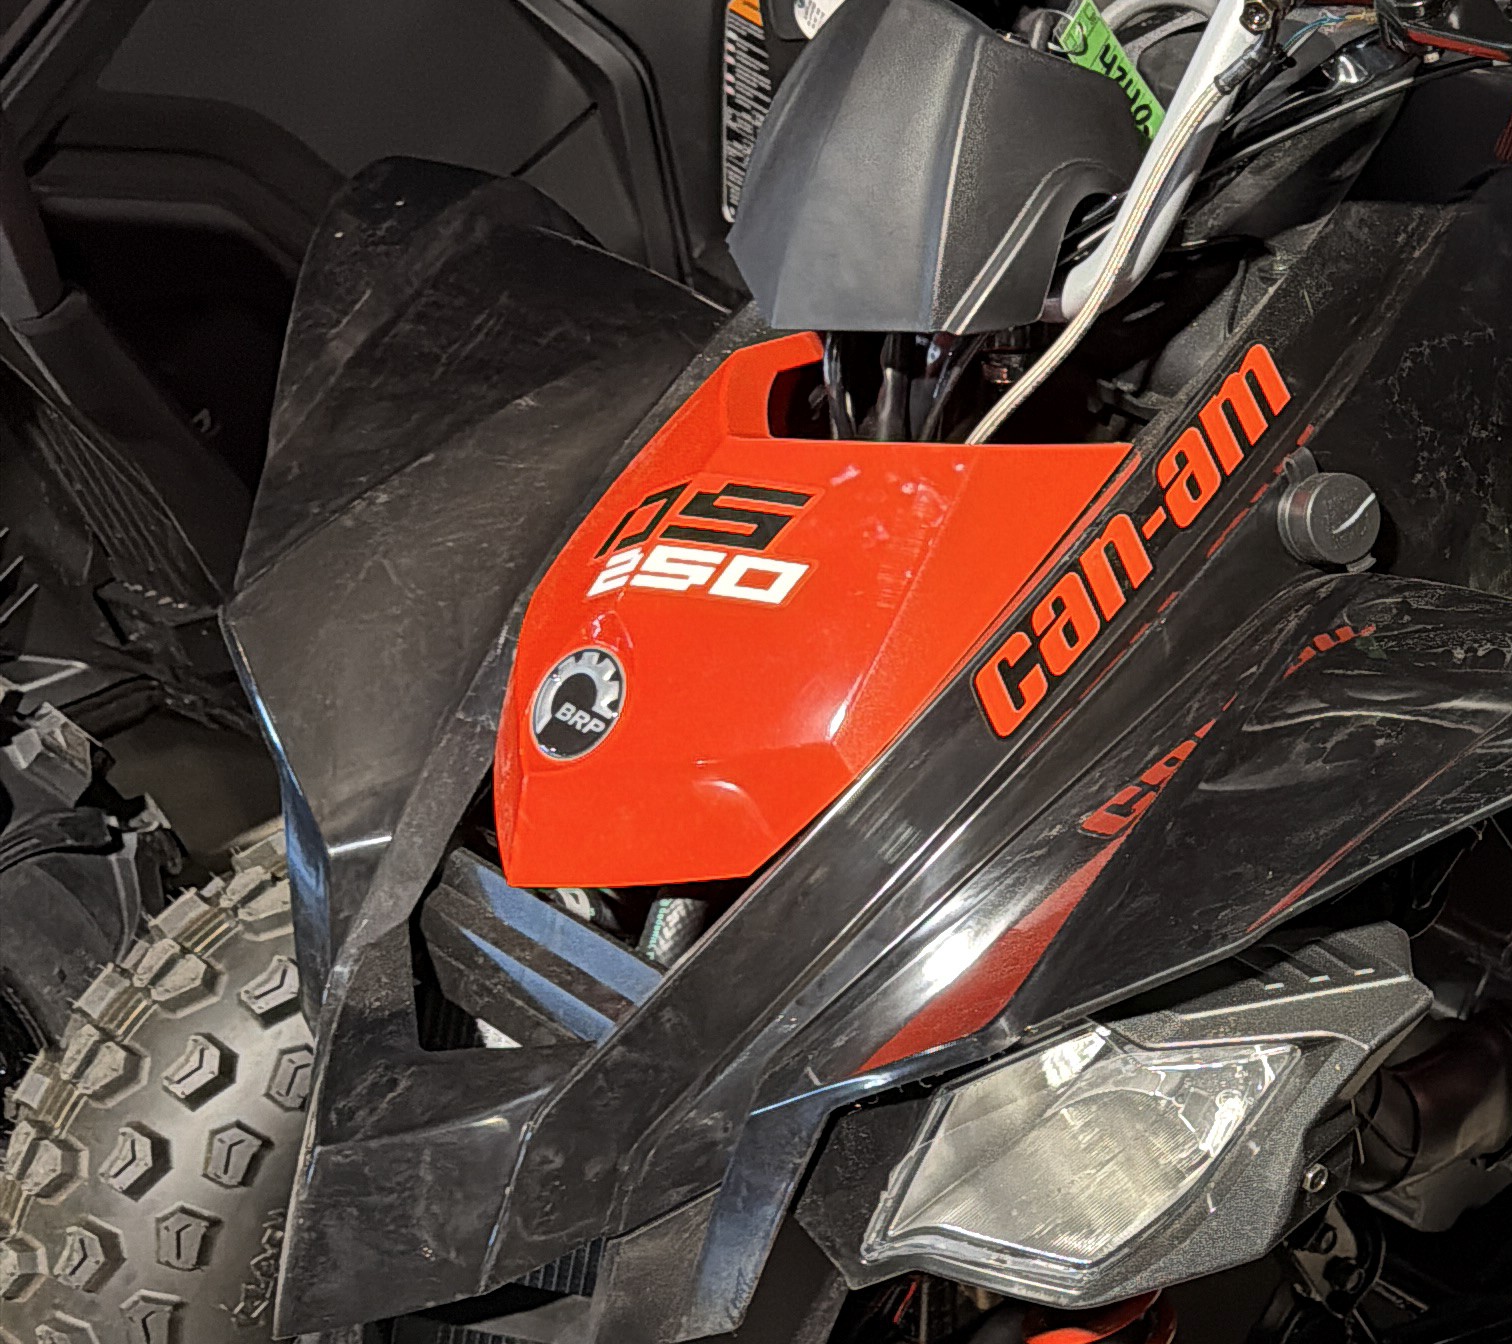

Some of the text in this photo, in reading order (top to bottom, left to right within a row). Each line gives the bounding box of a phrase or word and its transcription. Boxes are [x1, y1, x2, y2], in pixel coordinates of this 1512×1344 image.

[593, 479, 817, 560] DS
[974, 343, 1292, 738] can-am
[585, 544, 810, 605] 250
[554, 701, 606, 734] BRP
